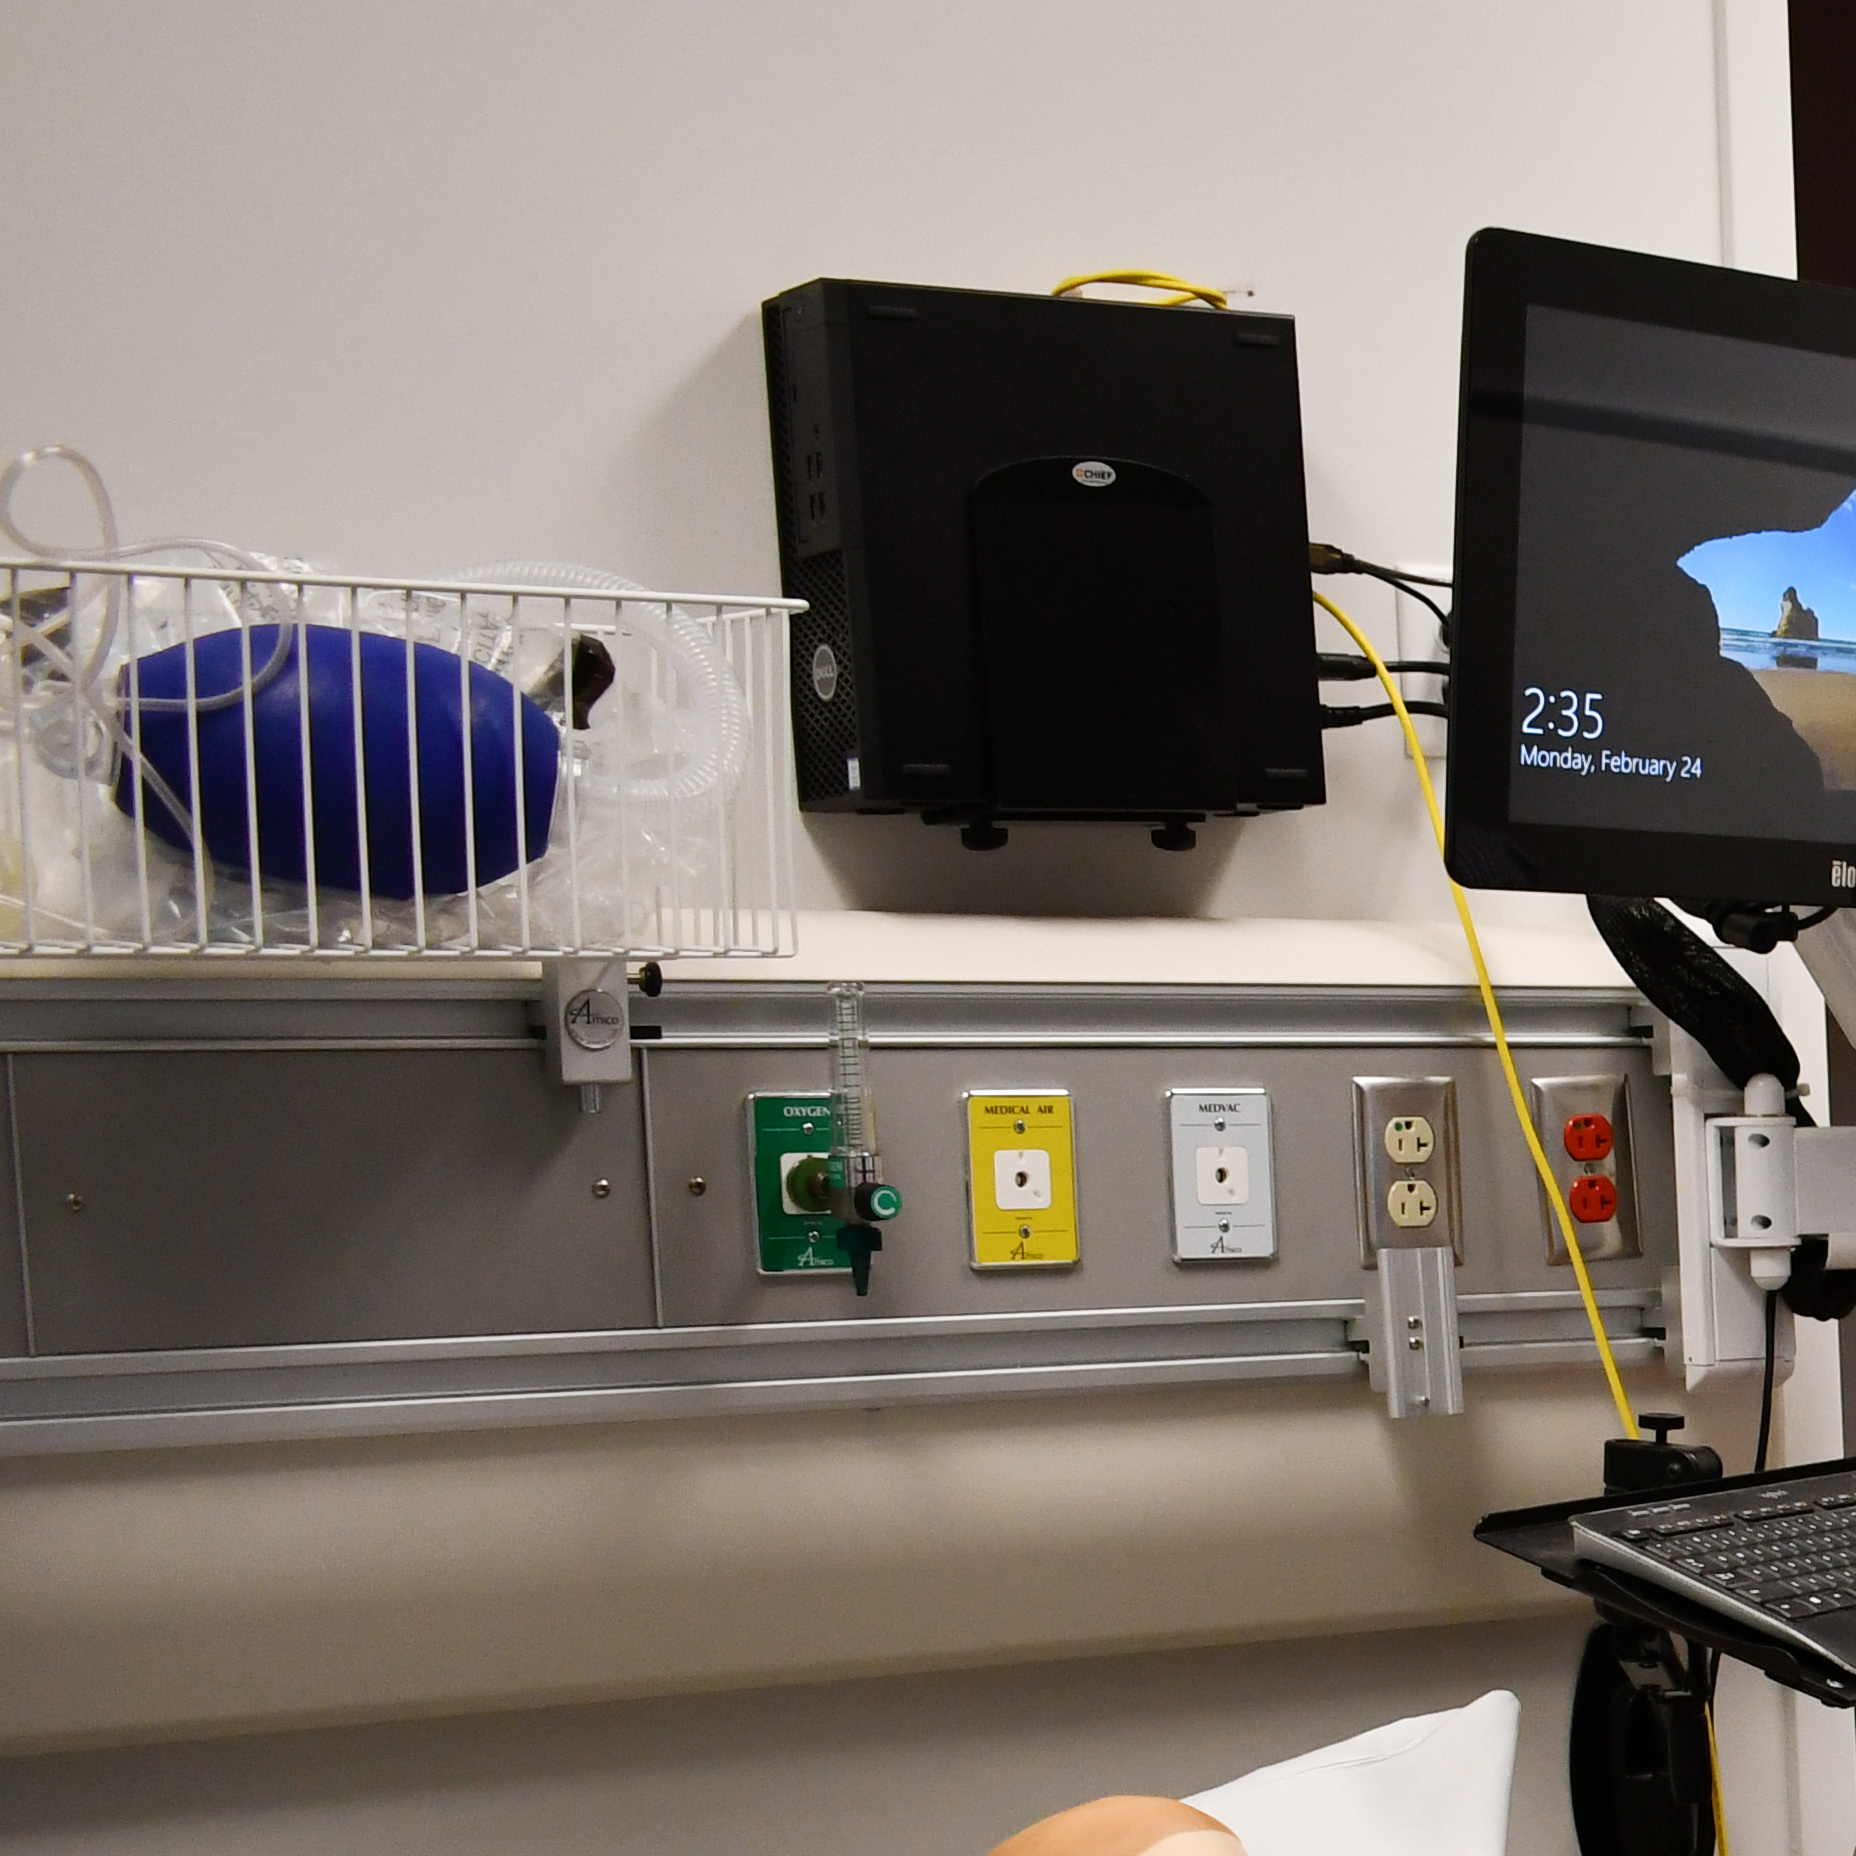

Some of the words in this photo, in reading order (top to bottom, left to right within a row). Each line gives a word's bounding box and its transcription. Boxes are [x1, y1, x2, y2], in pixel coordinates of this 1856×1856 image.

[1084, 469, 1112, 480] CHIEF
[1522, 687, 1604, 739] 2:35
[1520, 744, 1595, 776] Monday,
[1601, 750, 1677, 783] February
[1680, 756, 1702, 779] 24
[783, 1106, 832, 1118] OXYGEN
[984, 1105, 1030, 1116] MEDICAL
[1036, 1105, 1054, 1115] AIR
[1199, 1103, 1241, 1113] MEDVAC
